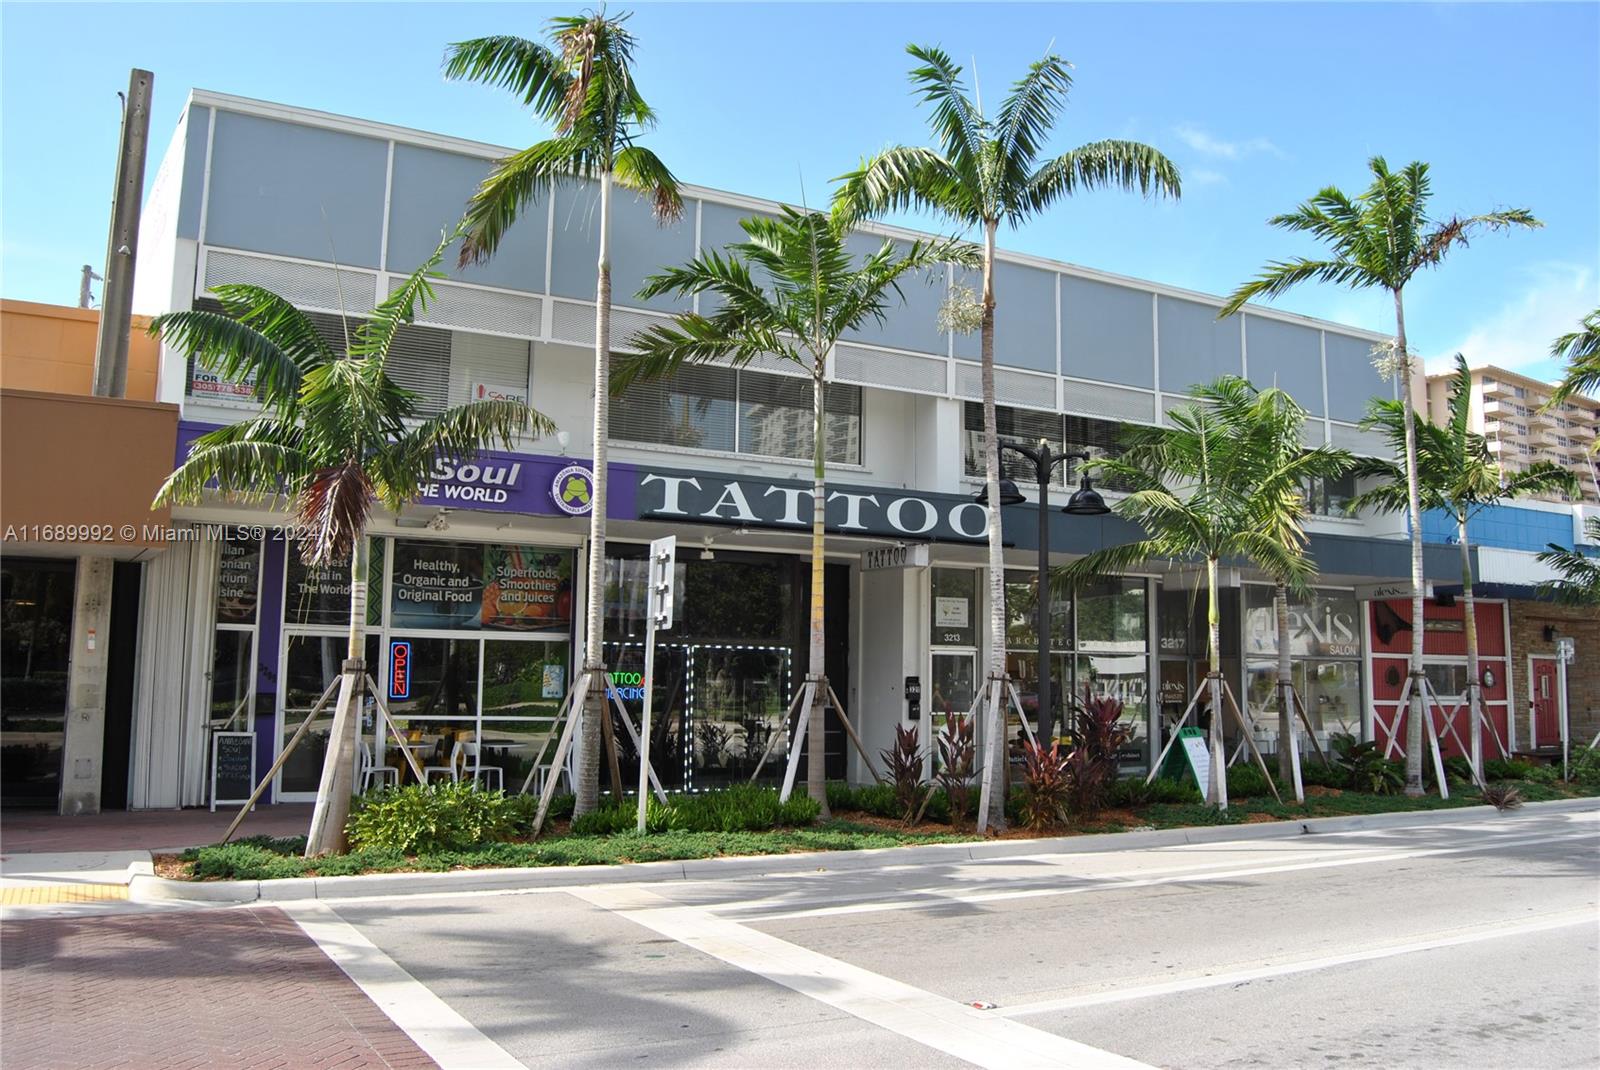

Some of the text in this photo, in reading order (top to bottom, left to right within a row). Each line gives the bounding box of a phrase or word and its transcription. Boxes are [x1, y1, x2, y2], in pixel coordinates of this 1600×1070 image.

[195, 374, 218, 382] FOR
[431, 458, 520, 485] Soul
[417, 482, 507, 503] HE WORLD
[640, 473, 993, 538] TATTOO
[868, 547, 907, 569] TATTOO
[413, 559, 460, 573] Healthy,
[496, 566, 560, 579] Superfoods,
[332, 570, 342, 580] in
[403, 573, 469, 588] Organic and
[298, 583, 351, 596] The World
[499, 578, 557, 591] Smoothies
[398, 589, 473, 602] Original Food
[500, 591, 554, 603] and Juices
[944, 633, 960, 642] 3213
[1160, 637, 1185, 649] 3217
[1329, 644, 1356, 656] SALON
[394, 645, 408, 695] OPEN
[608, 671, 642, 684] ATTOO
